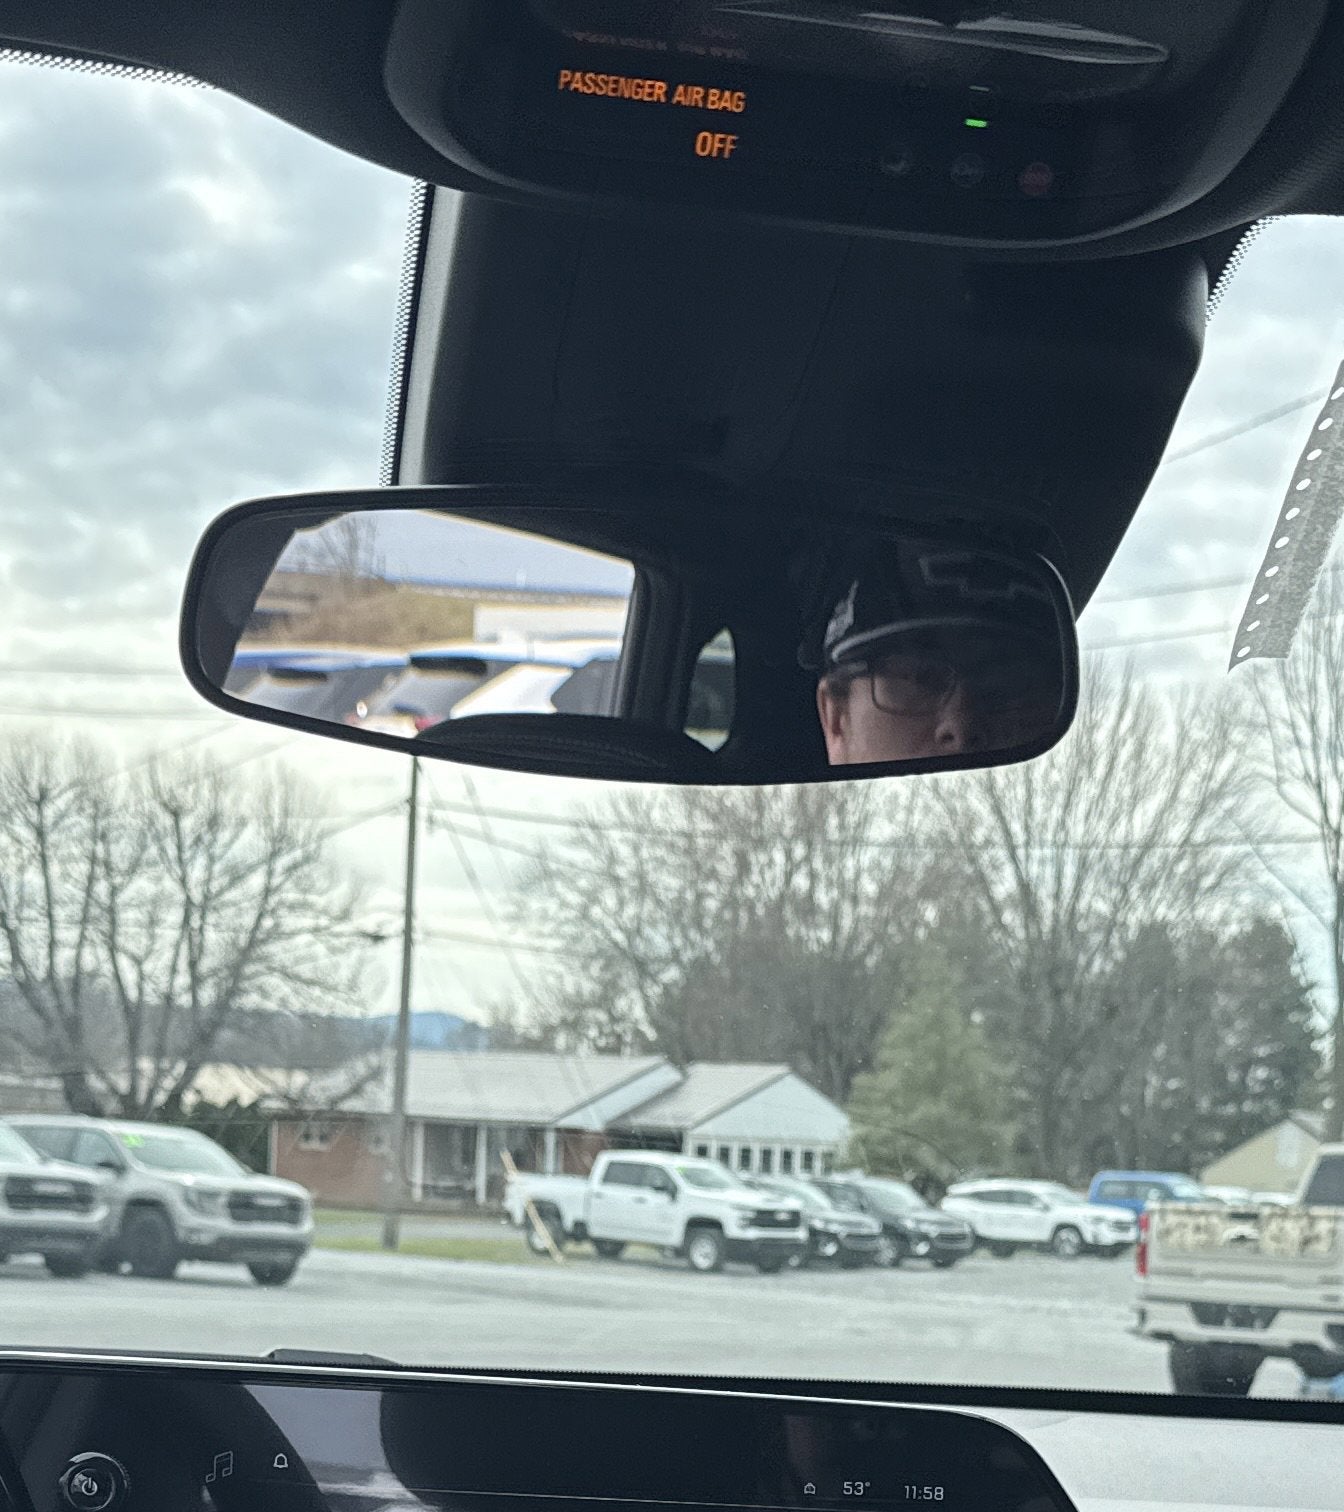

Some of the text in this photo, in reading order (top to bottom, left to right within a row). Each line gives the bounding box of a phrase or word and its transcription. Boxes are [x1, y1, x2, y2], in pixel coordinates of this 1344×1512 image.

[558, 69, 746, 113] PASSENGER AIR BAG
[695, 131, 737, 159] OFF
[843, 1481, 945, 1501] 53° 11:58
